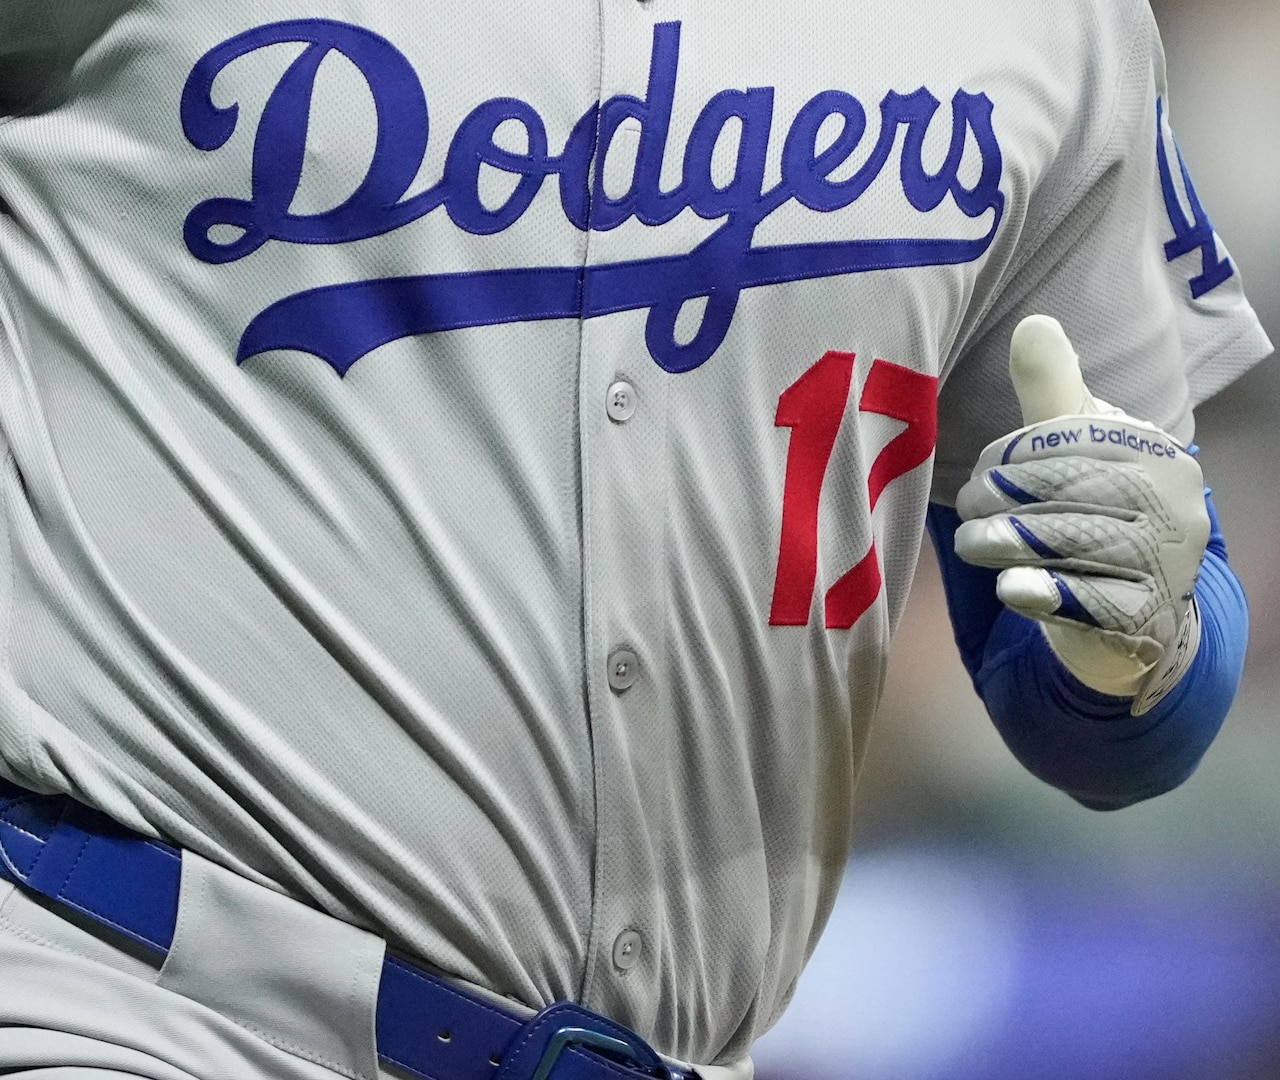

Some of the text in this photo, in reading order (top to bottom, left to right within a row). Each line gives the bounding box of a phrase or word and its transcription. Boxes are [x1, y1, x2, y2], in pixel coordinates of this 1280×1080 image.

[180, 18, 1004, 376] Dodgers
[769, 350, 938, 629] 17
[1031, 424, 1176, 459] new balance
